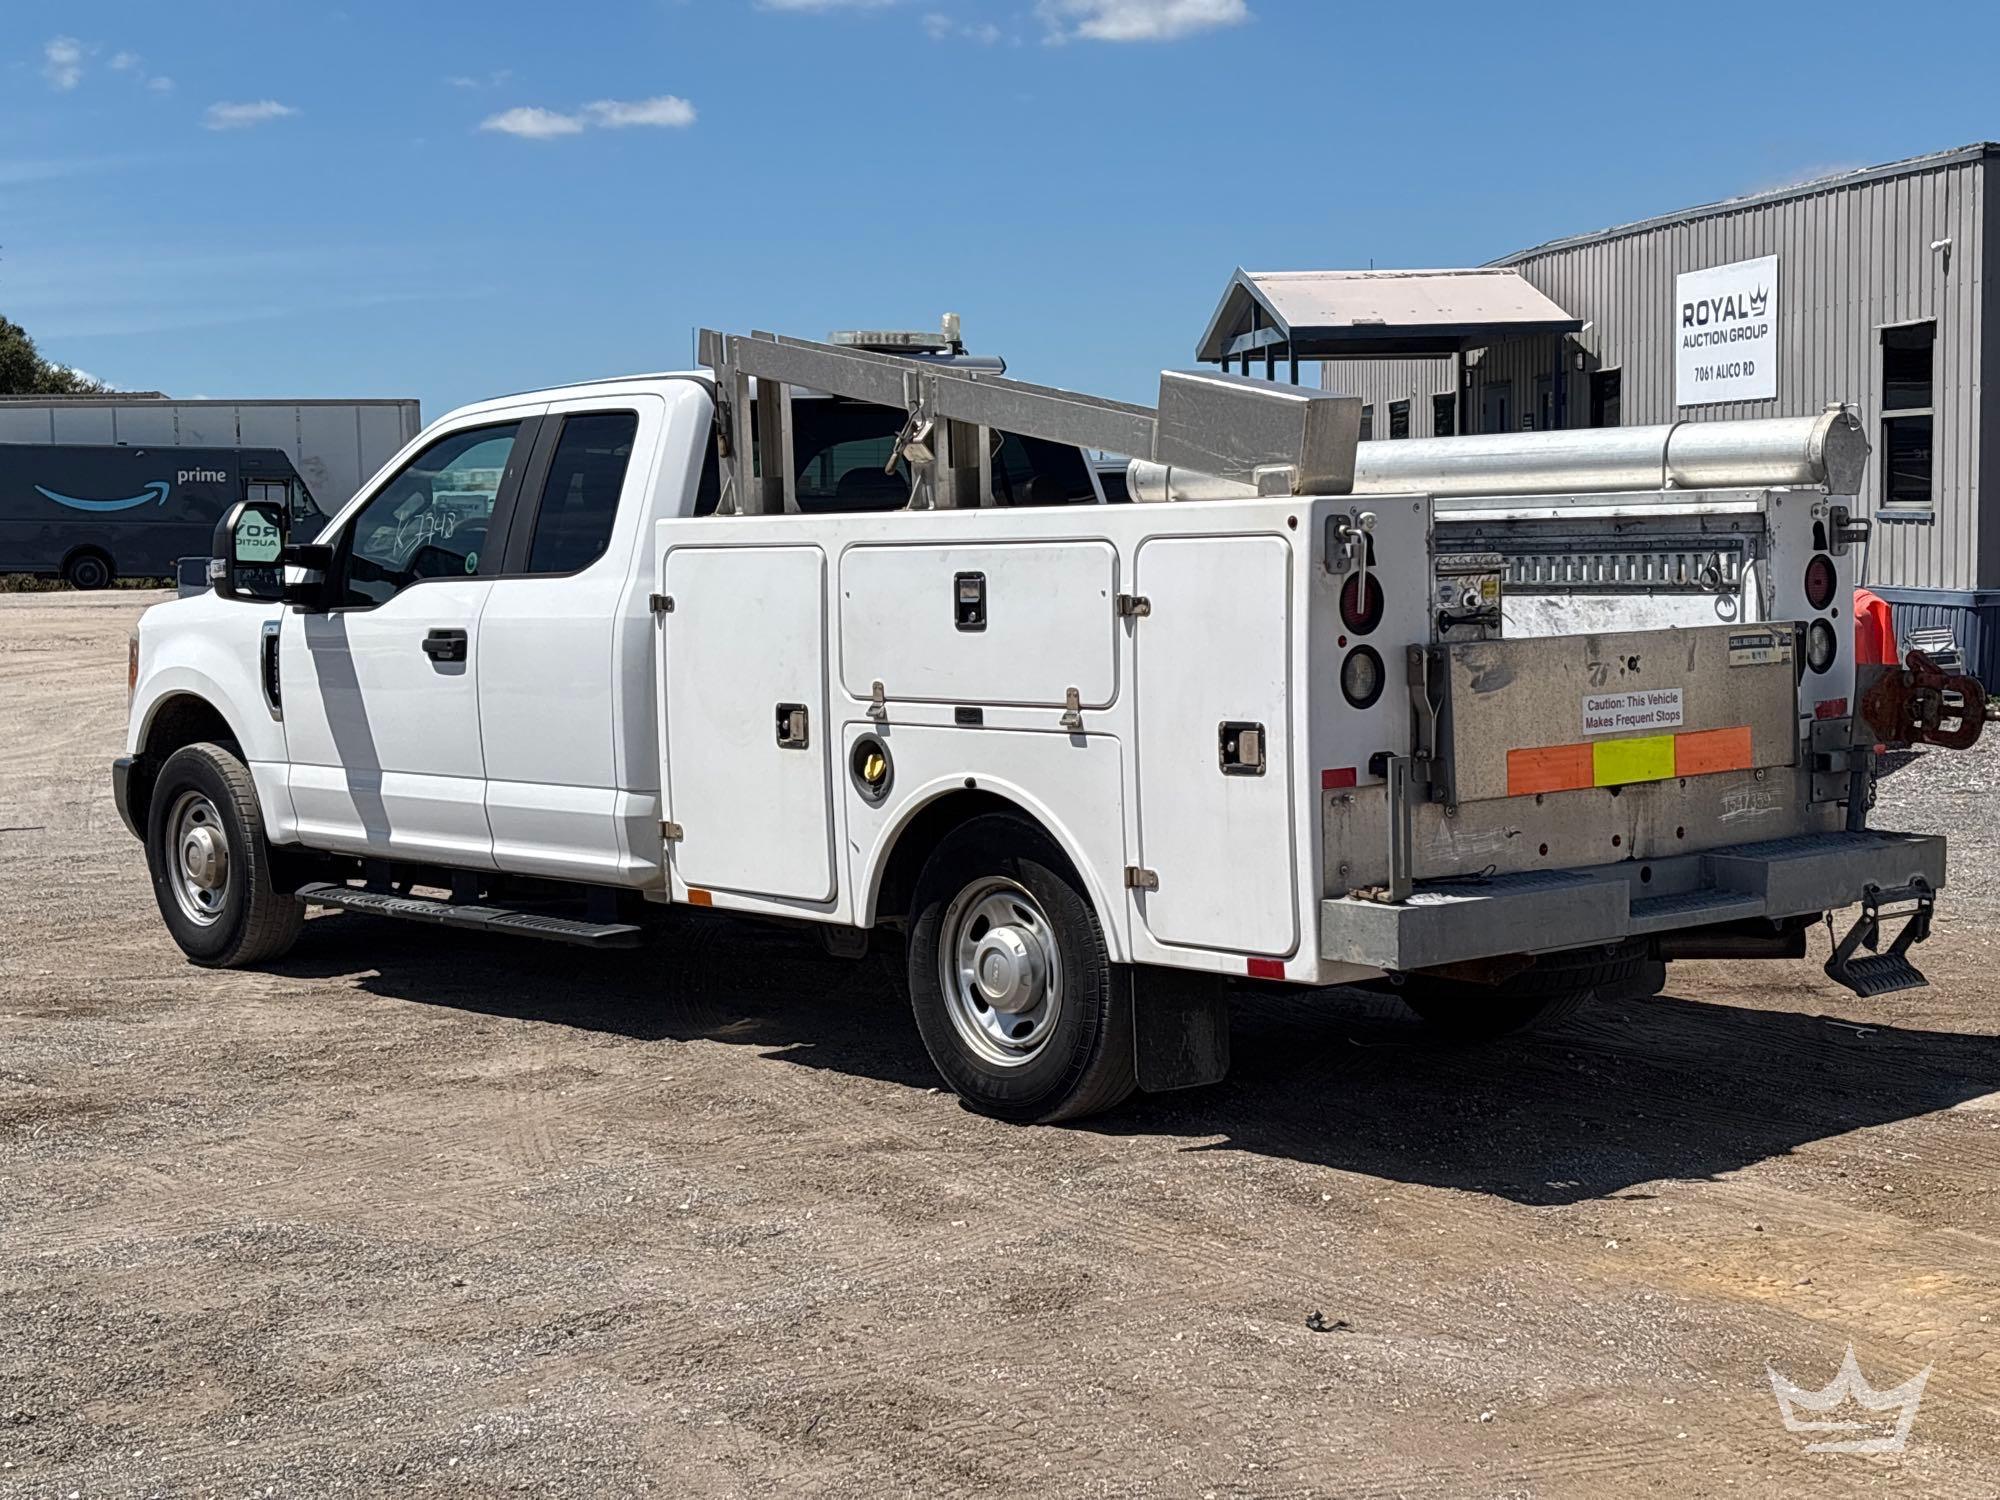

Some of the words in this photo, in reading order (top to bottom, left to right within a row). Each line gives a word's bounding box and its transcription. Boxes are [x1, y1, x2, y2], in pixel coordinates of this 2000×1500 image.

[1682, 294, 1748, 328] ROYAL
[1682, 330, 1727, 349] AUCTION
[1729, 323, 1768, 343] GROUP
[1694, 365, 1714, 382] 7061
[1716, 362, 1741, 379] ALICO
[1743, 360, 1755, 376] RD
[177, 466, 226, 485] prime
[1588, 698, 1625, 711] Caution:
[1627, 695, 1646, 707] This
[1647, 692, 1678, 705] Vehicle
[1585, 717, 1614, 729] Makes
[1616, 712, 1655, 727] Frequent
[1656, 710, 1680, 723] Stops
